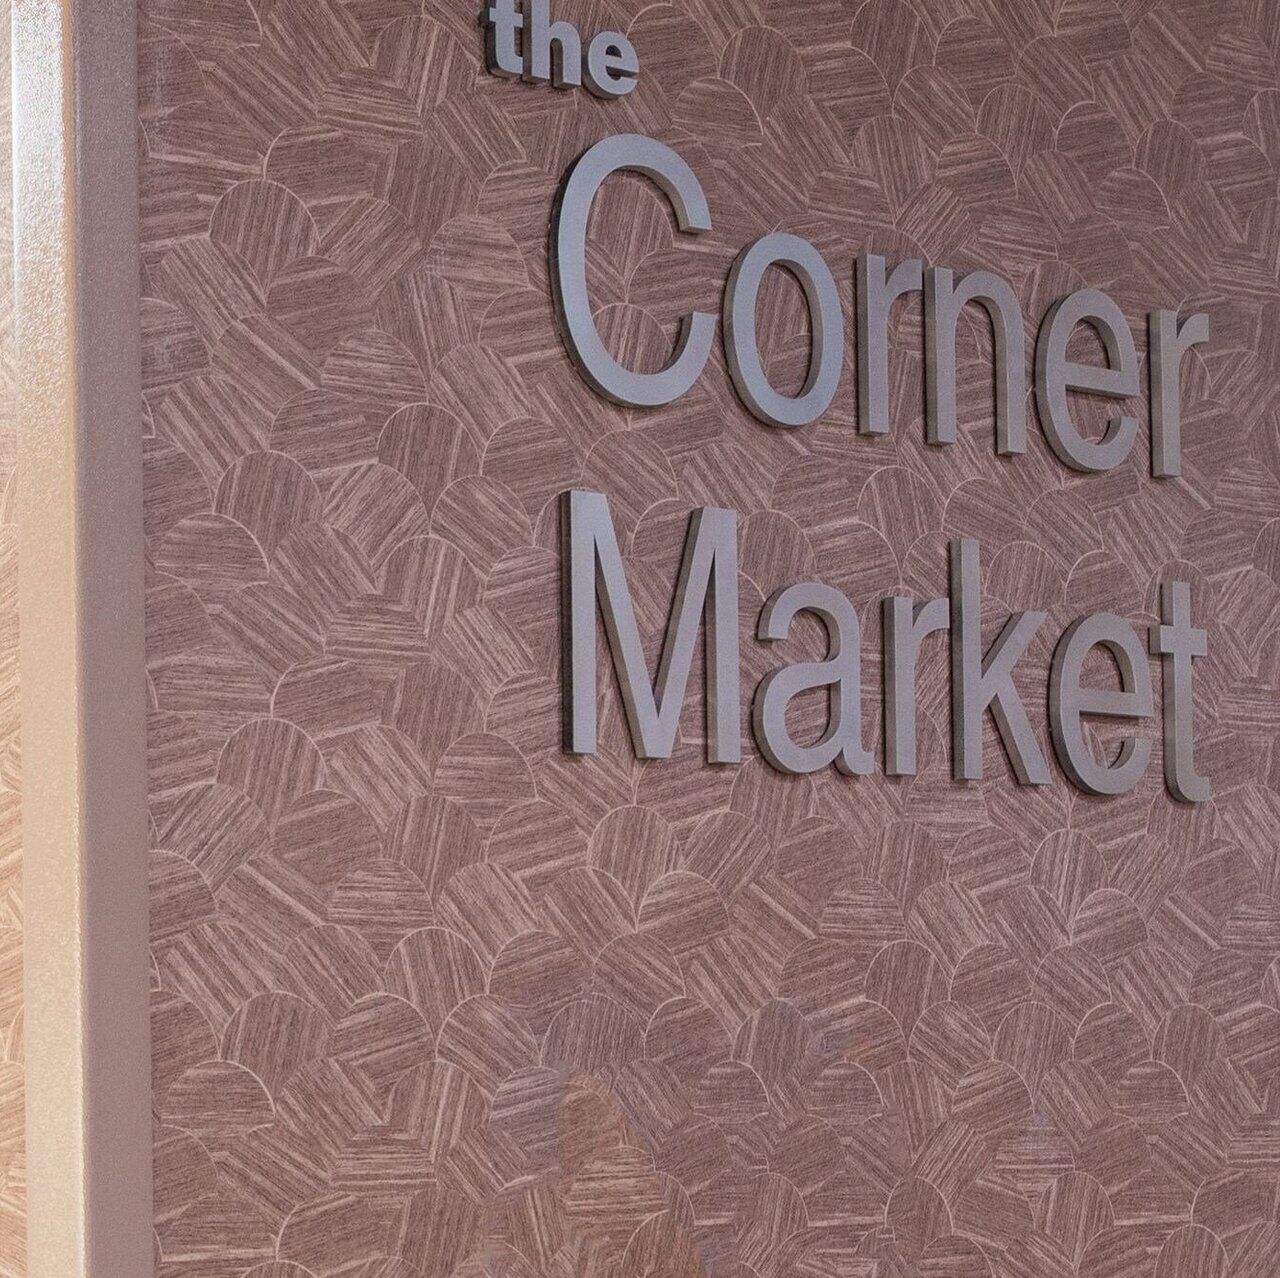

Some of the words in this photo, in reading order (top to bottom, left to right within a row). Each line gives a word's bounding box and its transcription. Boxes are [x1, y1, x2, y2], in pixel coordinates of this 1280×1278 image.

[483, 0, 640, 98] the
[551, 133, 1210, 478] Corner
[561, 489, 1210, 803] Market
